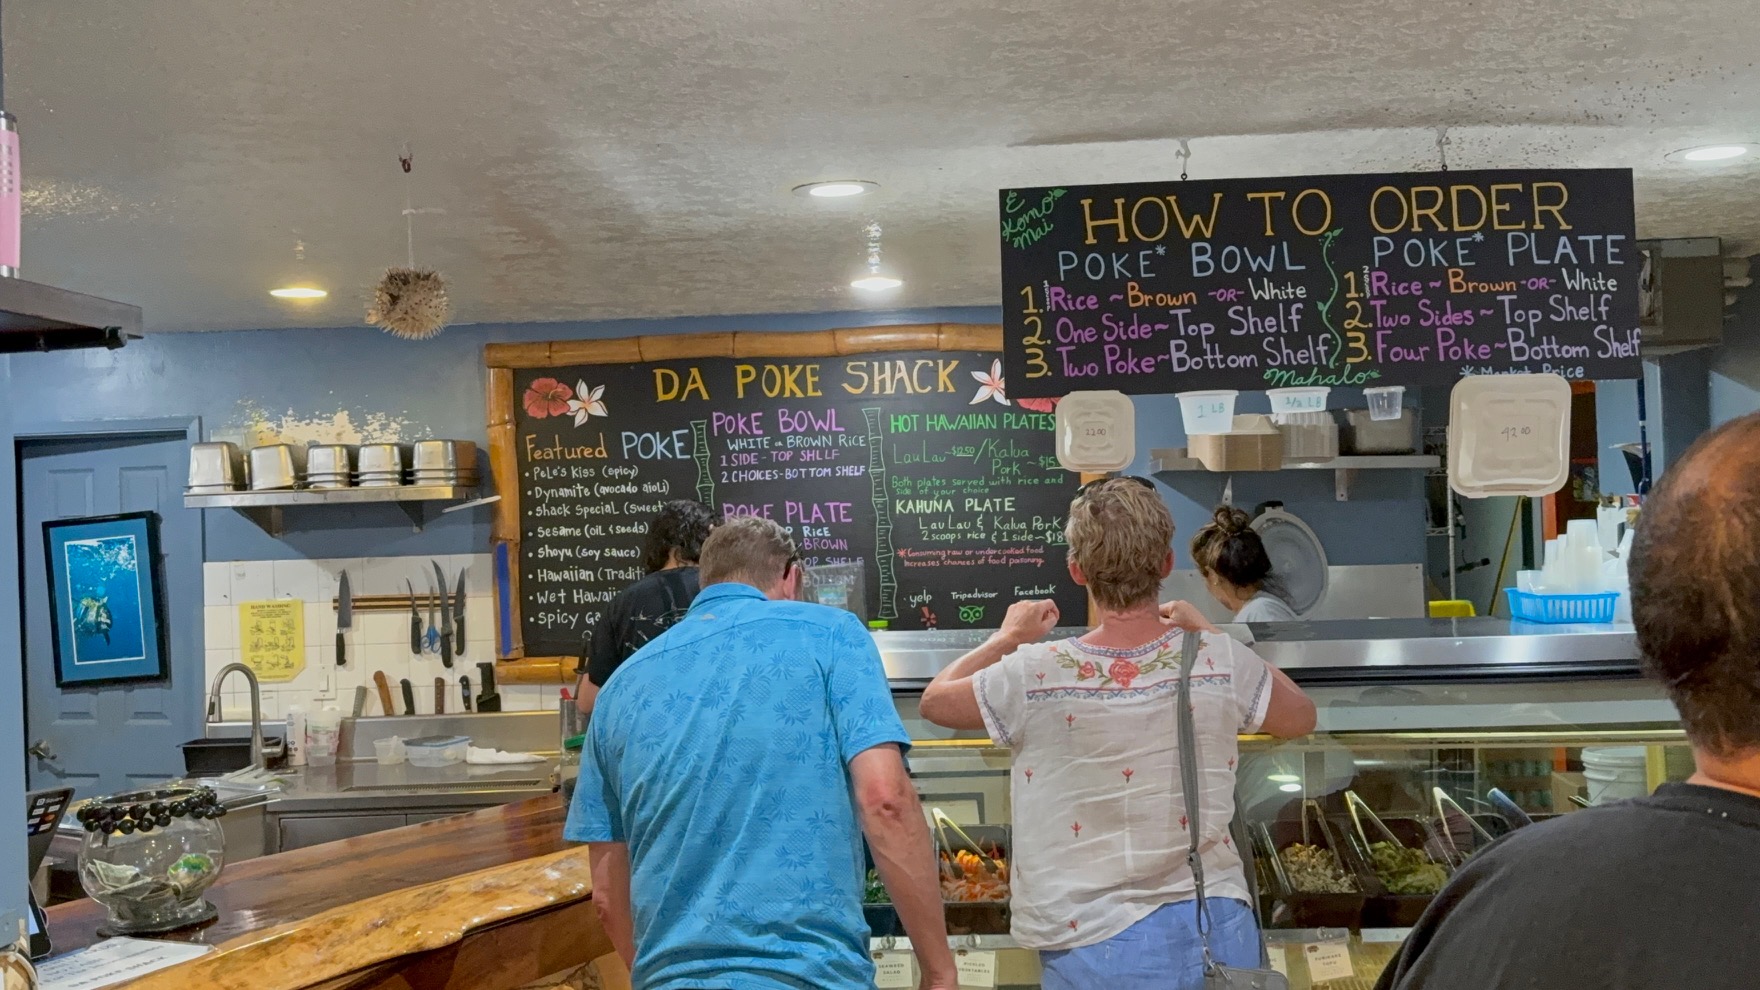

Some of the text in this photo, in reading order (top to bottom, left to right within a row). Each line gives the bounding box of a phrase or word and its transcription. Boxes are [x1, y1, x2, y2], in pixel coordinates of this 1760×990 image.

[1080, 182, 1572, 244] HOW TO ORDER
[1507, 232, 1625, 266] PLATE
[1190, 241, 1306, 277] BOWL
[1344, 271, 1365, 298] 1.
[1370, 271, 1423, 296] Rice
[1448, 268, 1517, 293] Brown
[1561, 268, 1618, 292] White
[1020, 286, 1044, 314] 1.
[1050, 286, 1100, 311] Rice
[1127, 281, 1198, 307] Brown
[1247, 277, 1308, 301] White
[1022, 317, 1051, 345] 2.
[1056, 317, 1098, 343] One
[1228, 303, 1303, 336] Shelf
[1344, 294, 1612, 338] 2. Two Sides Top Shelf
[1346, 331, 1372, 363] 3.
[1376, 331, 1430, 363] Four
[1594, 324, 1642, 359] Shelf
[1026, 348, 1052, 378] 3.
[1056, 346, 1099, 377] Two
[1263, 332, 1331, 368] Shelf
[1263, 364, 1368, 387] Mahalo
[1542, 363, 1584, 378] Price
[652, 359, 960, 403] DA POKE SHACK
[1211, 402, 1225, 413] LB
[1308, 396, 1321, 408] LB
[712, 408, 845, 436] POKE BOWL
[890, 413, 1056, 434] HOT HAWAIIAN PLATES
[526, 428, 692, 462] Featured POKE
[727, 436, 771, 451] WHITE
[787, 435, 832, 449] BROWN
[988, 438, 1030, 459] Kalua
[720, 455, 729, 467] 1
[731, 453, 759, 466] SIDE
[770, 450, 793, 462] TOP
[991, 459, 1021, 475] Pork
[602, 465, 639, 480] (spicy)
[721, 471, 729, 483] 2
[835, 465, 866, 477] SHELF
[891, 474, 1064, 490] Both plates served with rice and
[535, 482, 591, 502] Dynamite
[594, 482, 638, 498] (avocado
[896, 486, 989, 499] side of your choice
[785, 500, 853, 524] PLATE
[896, 497, 1016, 514] KAHUNA PLATE
[615, 521, 649, 535] seeds)
[994, 516, 1027, 531] Kalua
[1032, 516, 1062, 531] Pork
[922, 531, 929, 540] 2
[931, 531, 961, 543] scoops
[967, 531, 986, 539] rice
[1002, 532, 1008, 541] 1
[576, 546, 600, 561] (soy
[603, 545, 641, 558] sauce)
[1026, 545, 1044, 554] food
[803, 556, 819, 568] OP
[988, 555, 1006, 564] food
[537, 565, 646, 582] Hawaiian (Traditi
[537, 587, 622, 604] Wet Hawaii
[909, 589, 932, 608] yelp
[951, 588, 998, 601] Tripadvisor
[1014, 584, 1057, 597] Facebook
[585, 611, 601, 625] Ga
